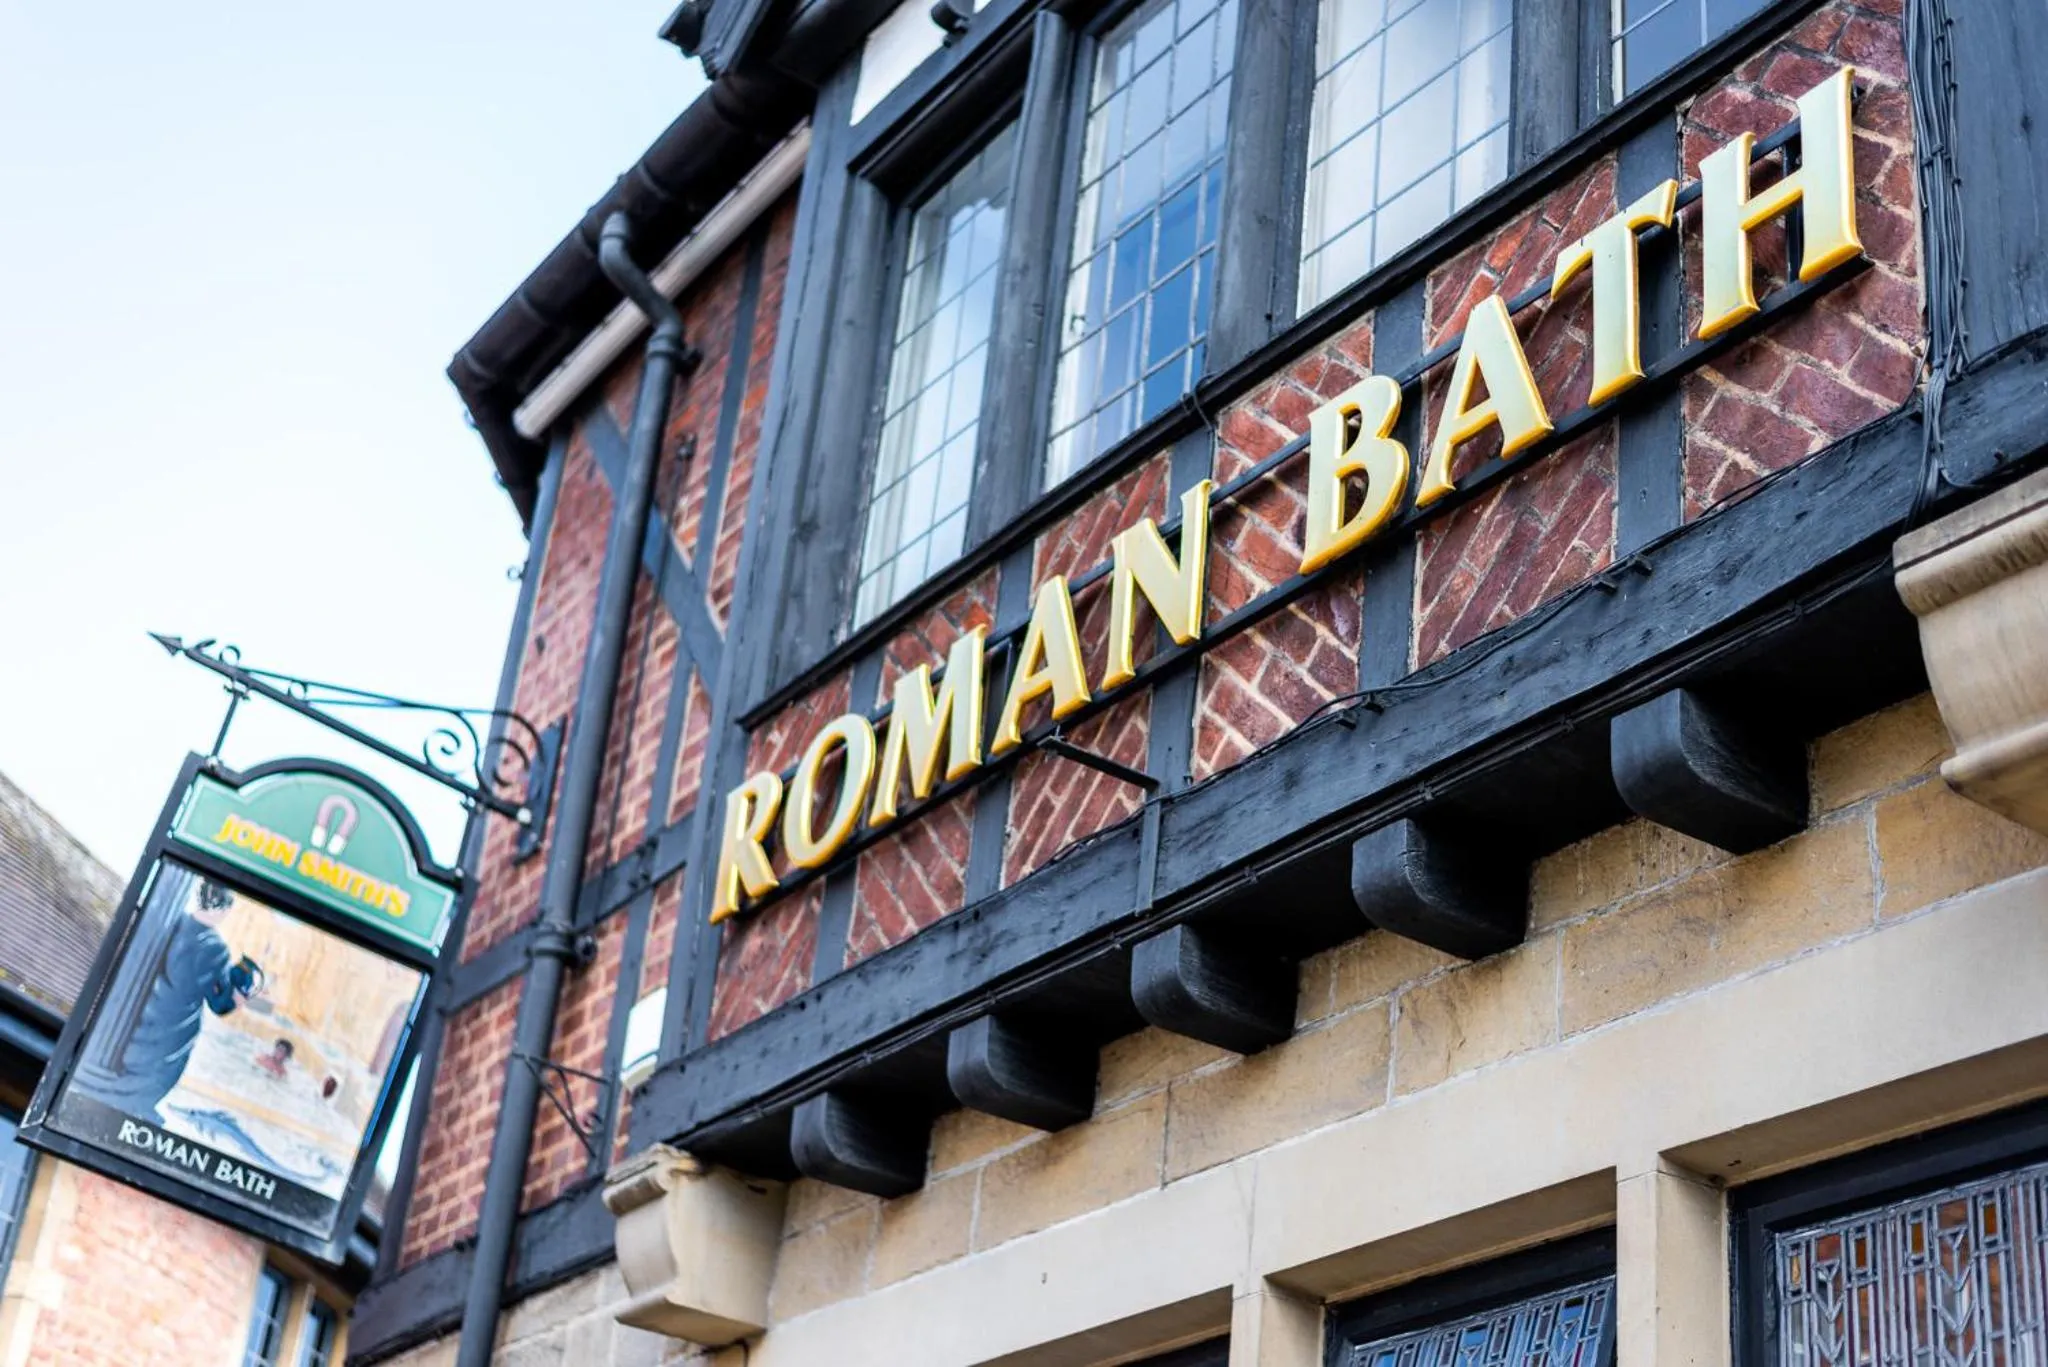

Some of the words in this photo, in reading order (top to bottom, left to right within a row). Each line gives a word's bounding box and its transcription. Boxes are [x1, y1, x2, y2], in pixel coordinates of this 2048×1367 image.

[709, 479, 1212, 926] ROMAN
[1298, 65, 1865, 575] BATH
[213, 813, 301, 868] JOHN
[298, 849, 411, 918] SMITH'S
[117, 1119, 211, 1173] ROMAN
[213, 1158, 277, 1200] BATH
